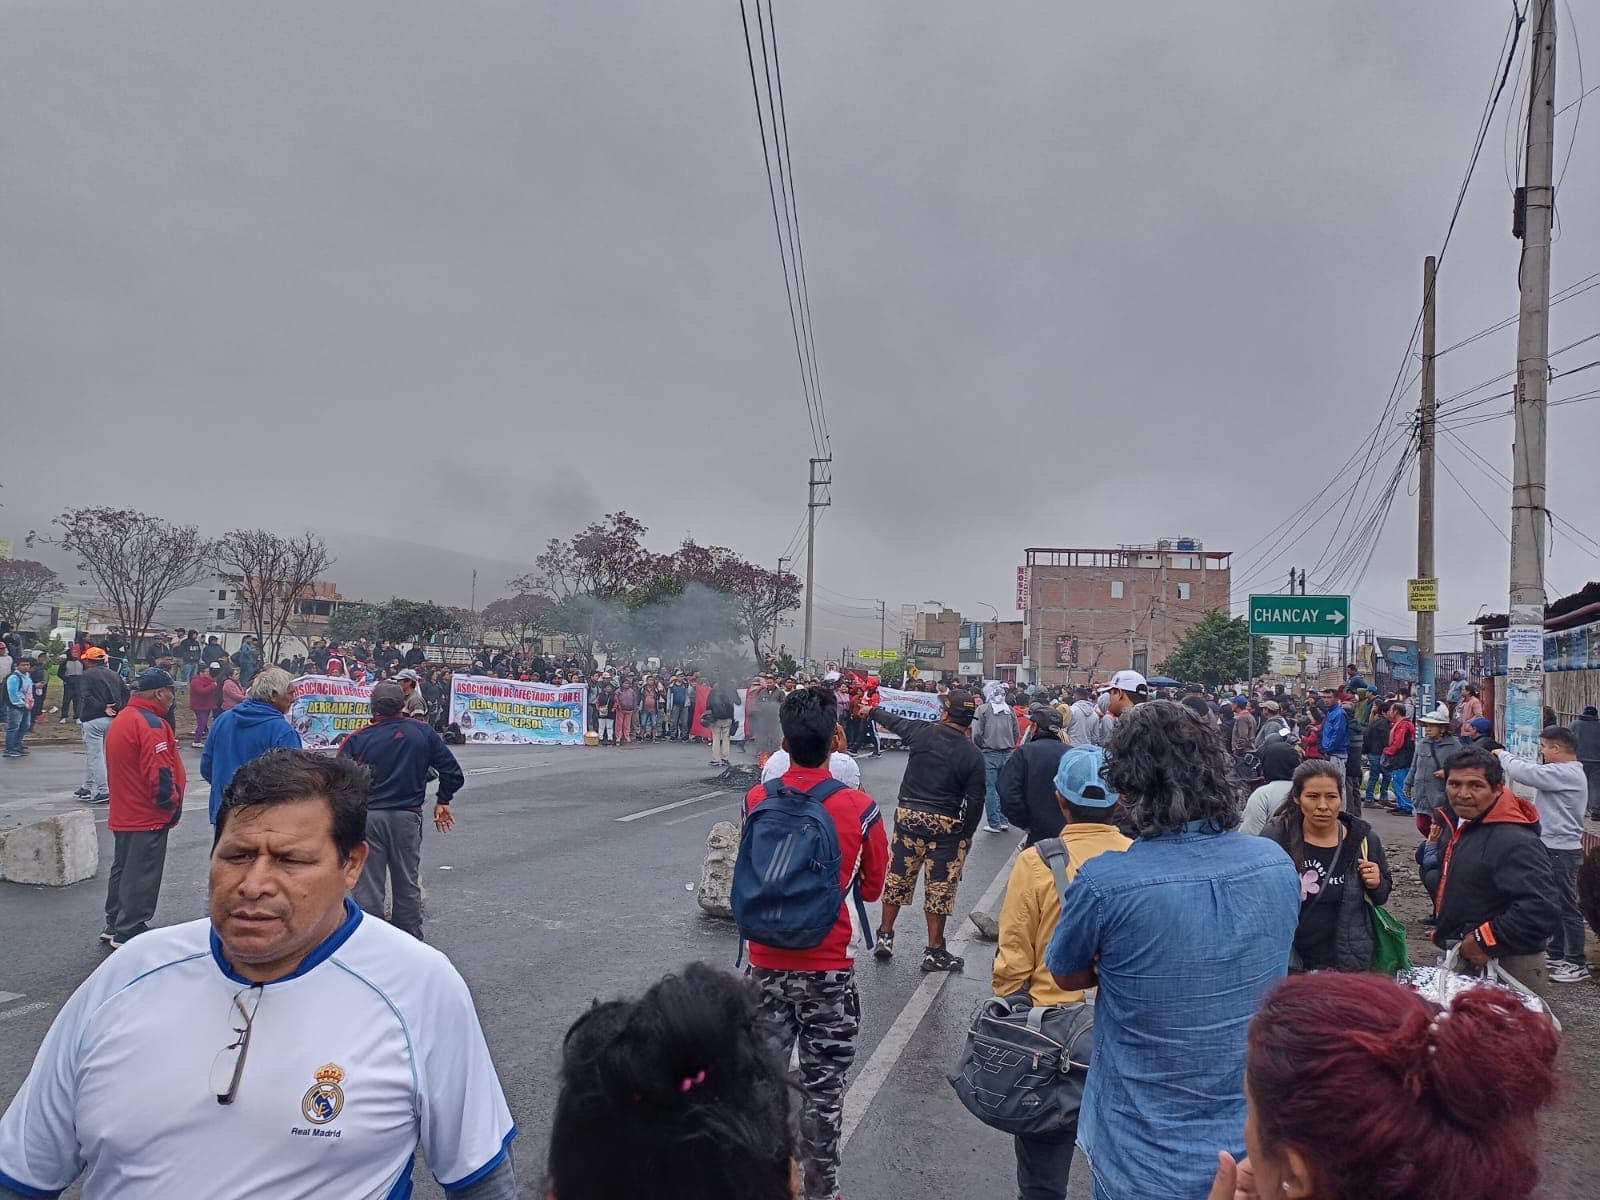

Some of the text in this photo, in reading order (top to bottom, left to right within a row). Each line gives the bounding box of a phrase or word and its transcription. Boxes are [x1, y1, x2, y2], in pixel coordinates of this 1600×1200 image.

[1254, 608, 1319, 623] CHANCAY
[504, 687, 514, 698] DE
[514, 688, 555, 702] AFECTADOS
[558, 691, 573, 702] POR
[308, 700, 355, 715] DERRAME
[355, 702, 368, 715] DE
[513, 703, 525, 715] DE
[526, 705, 571, 718] PETROLEO
[334, 718, 348, 730] DE
[508, 717, 543, 729] REPSOL
[291, 1127, 341, 1138] Real Madrid
